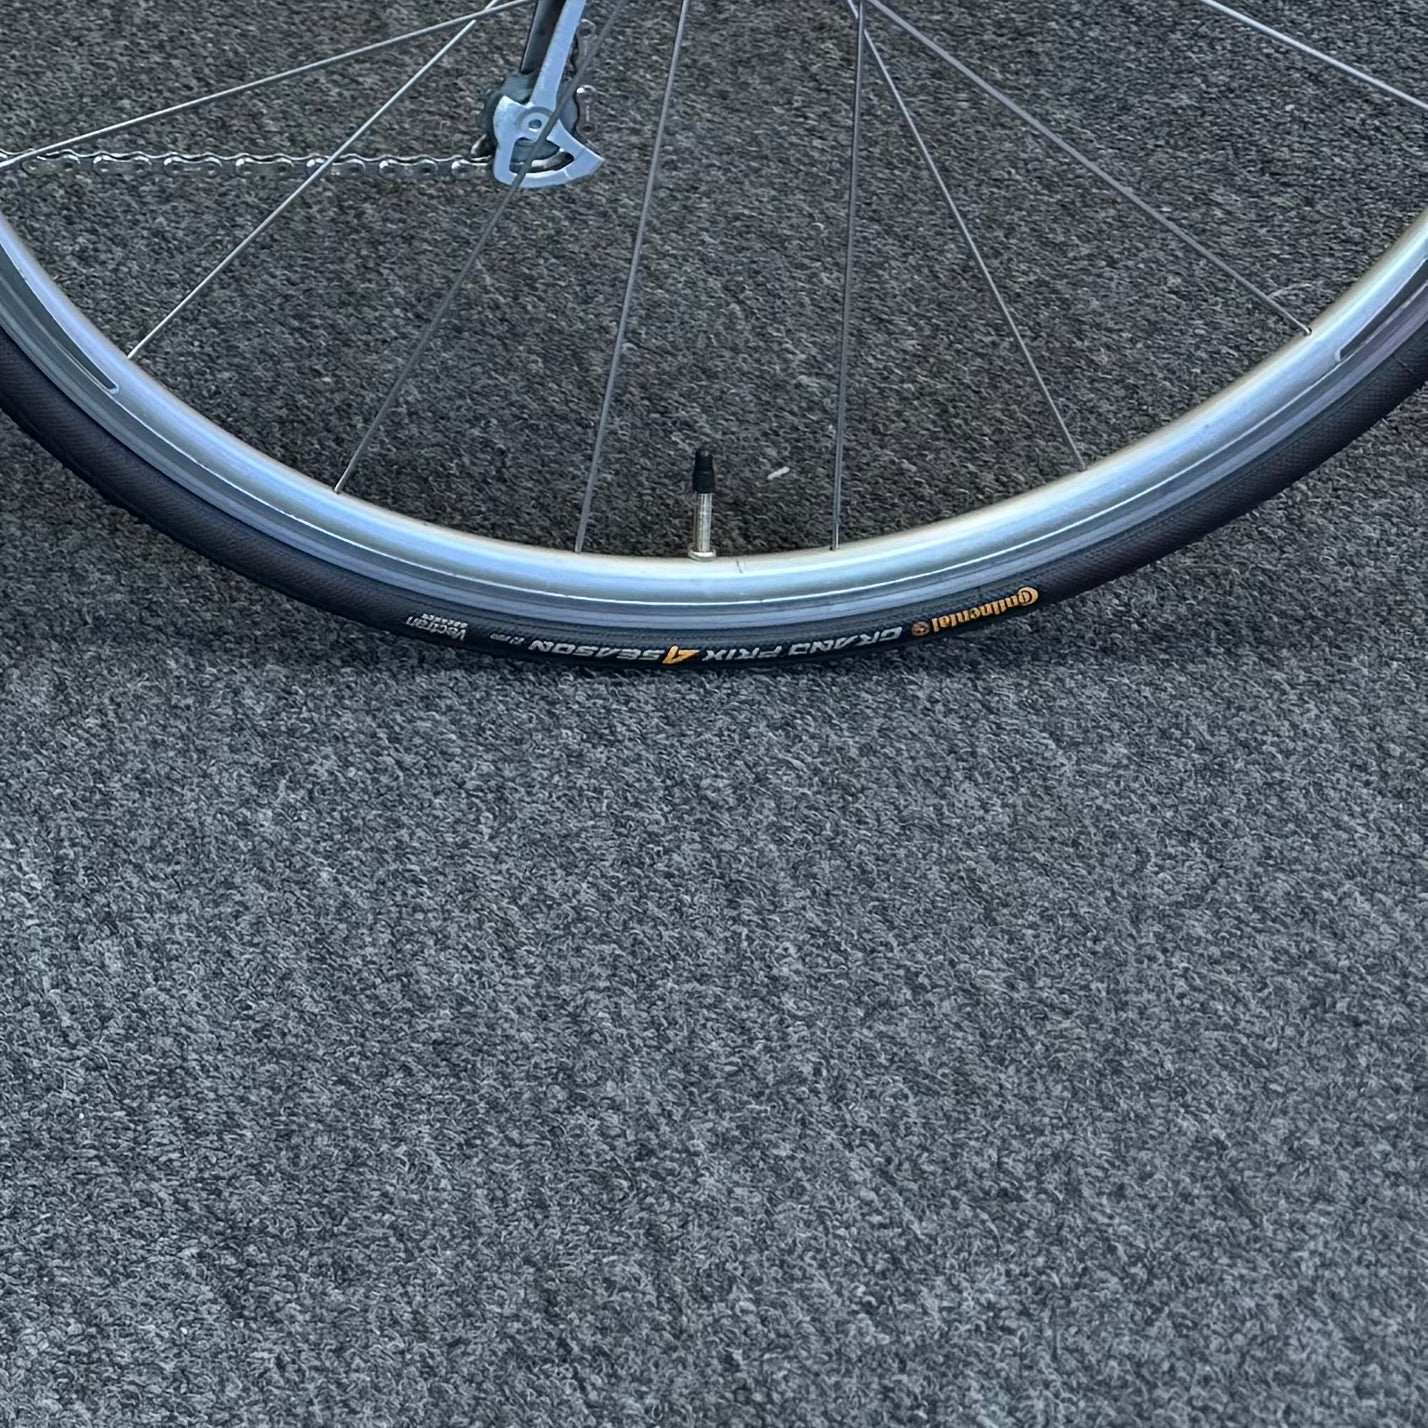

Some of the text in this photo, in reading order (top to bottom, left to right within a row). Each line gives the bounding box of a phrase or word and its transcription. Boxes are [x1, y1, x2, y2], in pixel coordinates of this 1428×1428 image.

[931, 586, 1040, 633] Continental
[405, 616, 467, 641] Vectran
[529, 639, 665, 661] SEASON
[789, 626, 904, 656] GRAND
[662, 644, 701, 666] 4
[702, 645, 783, 662] PRIX
